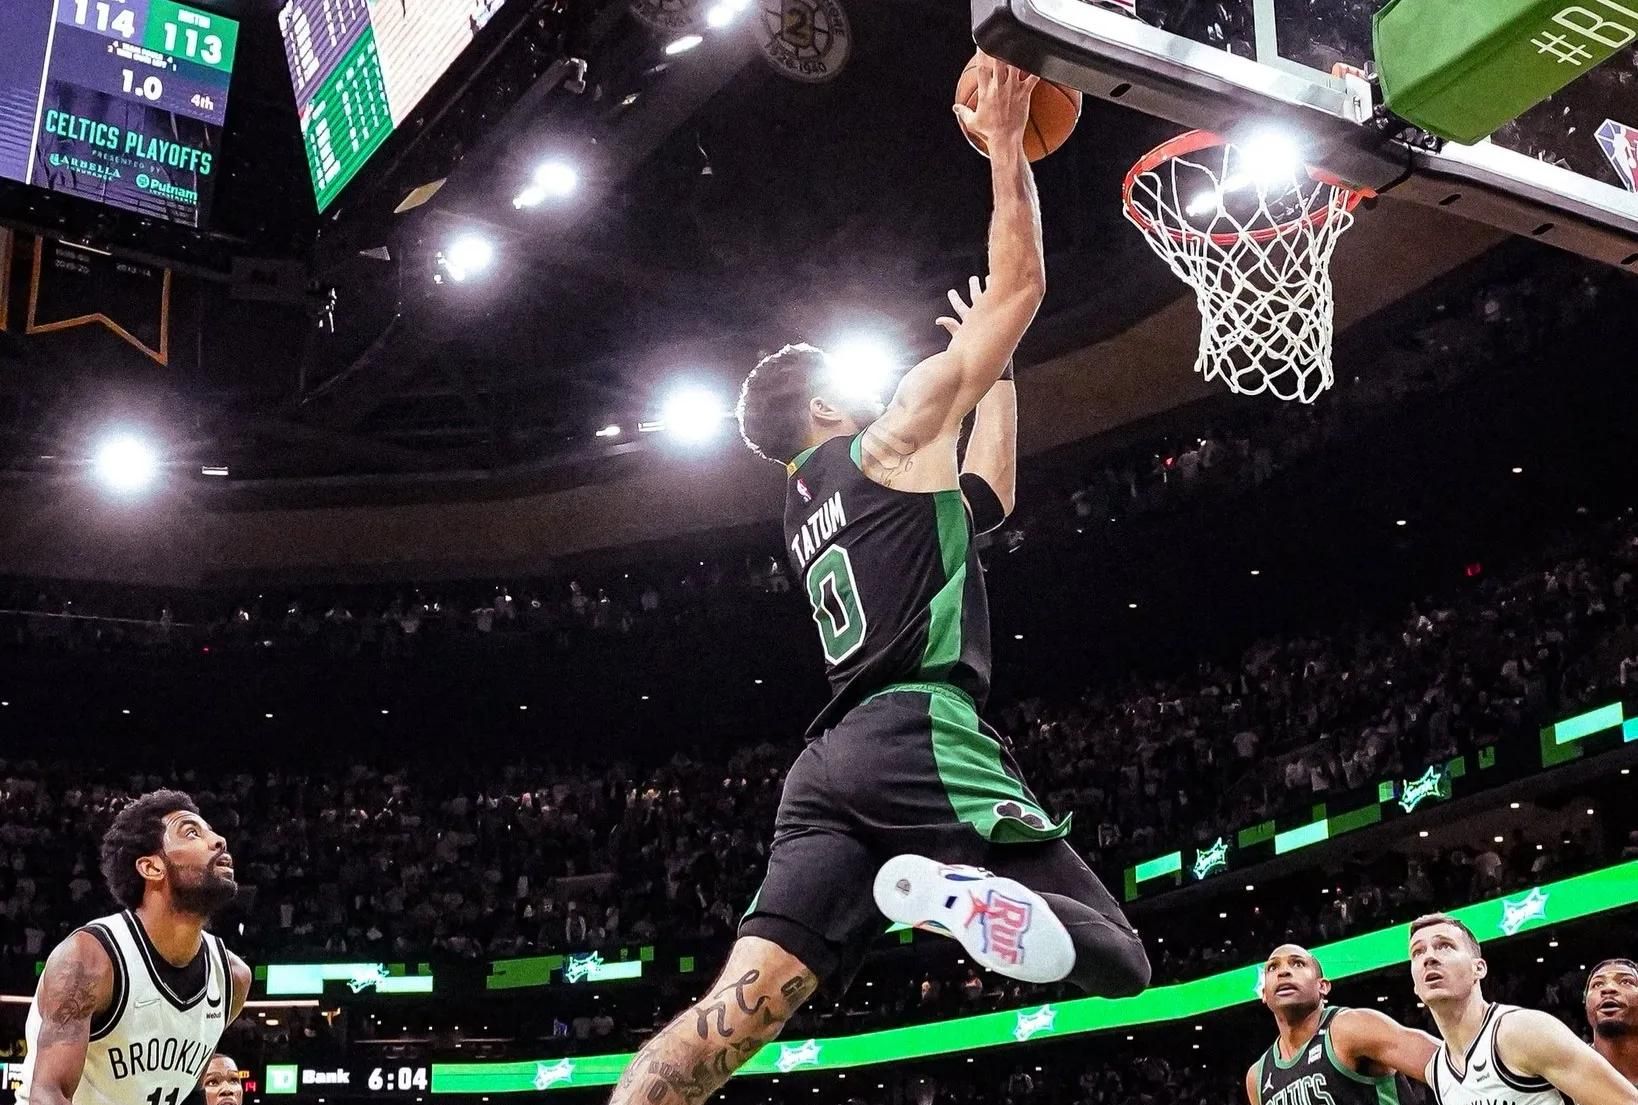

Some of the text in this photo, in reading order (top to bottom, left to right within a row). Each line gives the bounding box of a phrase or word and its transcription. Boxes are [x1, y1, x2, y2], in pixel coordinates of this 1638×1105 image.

[75, 0, 135, 38] 114
[164, 22, 222, 64] 113
[122, 69, 163, 101] 1.0
[190, 94, 214, 110] 4th
[45, 109, 213, 175] CELTICS PLAYOFFS
[60, 154, 121, 178] ARBELLA
[92, 150, 145, 169] PRESENTED
[150, 178, 197, 200] Putnam
[791, 491, 847, 568] TATUM
[806, 543, 867, 666] 0
[107, 1037, 212, 1080] BROOKLY
[302, 1068, 350, 1084] Bank
[368, 1067, 428, 1091] 6:04
